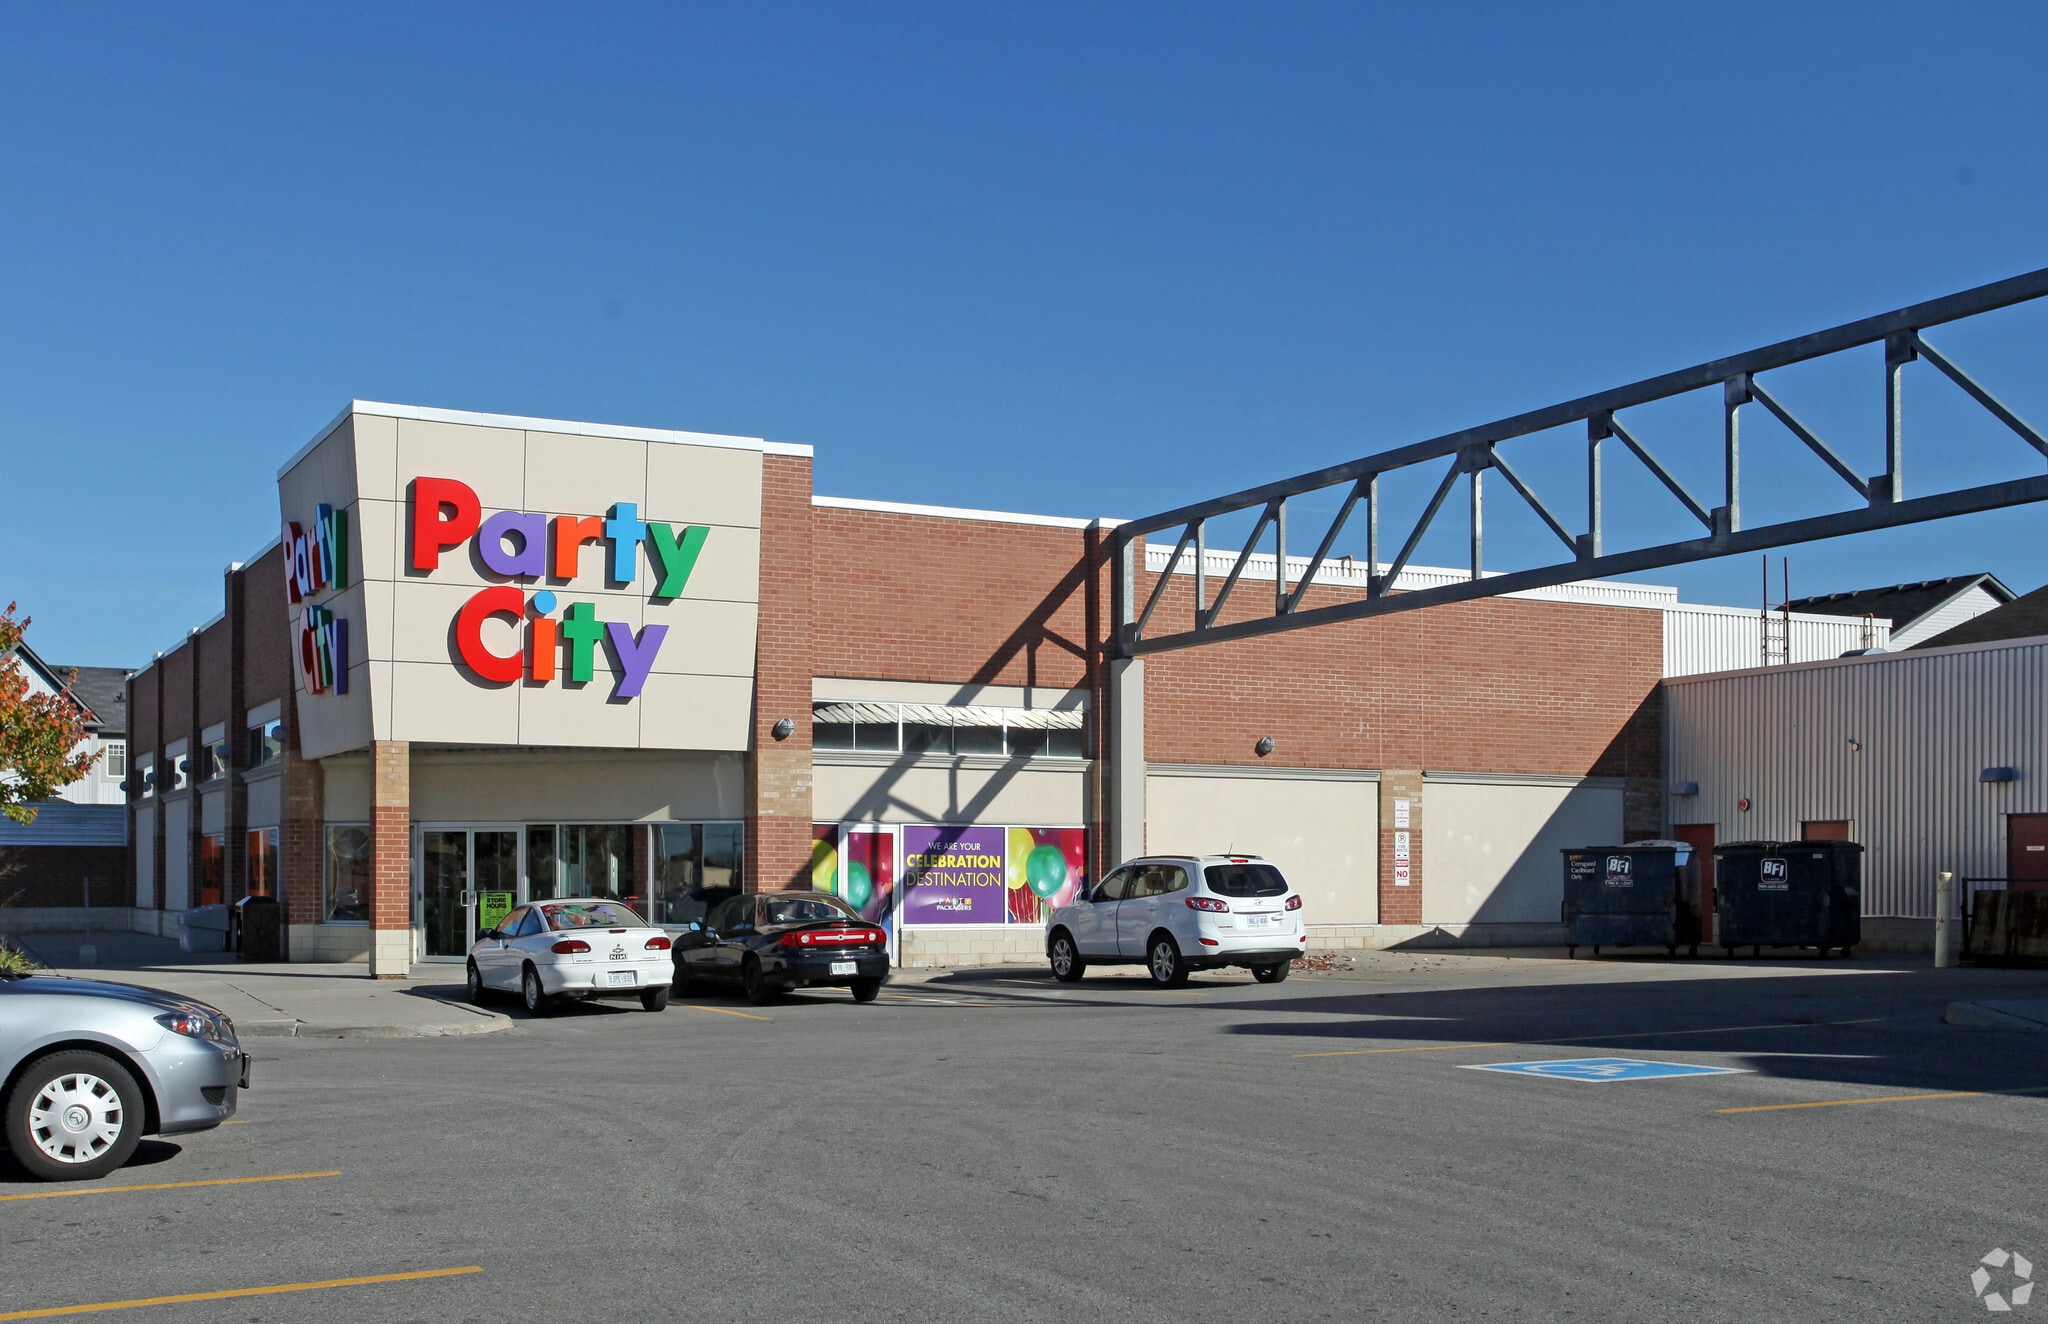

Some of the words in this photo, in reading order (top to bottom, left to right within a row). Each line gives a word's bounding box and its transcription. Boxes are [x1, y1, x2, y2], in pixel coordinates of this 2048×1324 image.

[412, 476, 711, 599] Party
[281, 503, 347, 605] Party
[456, 585, 670, 698] City
[928, 842, 942, 850] WE
[943, 842, 958, 851] ARE
[960, 842, 981, 851] YOUR
[906, 854, 1001, 868] CELEBRATION
[1609, 858, 1629, 874] BFI
[1763, 861, 1785, 877] BFI
[906, 872, 1001, 887] DESTINATION
